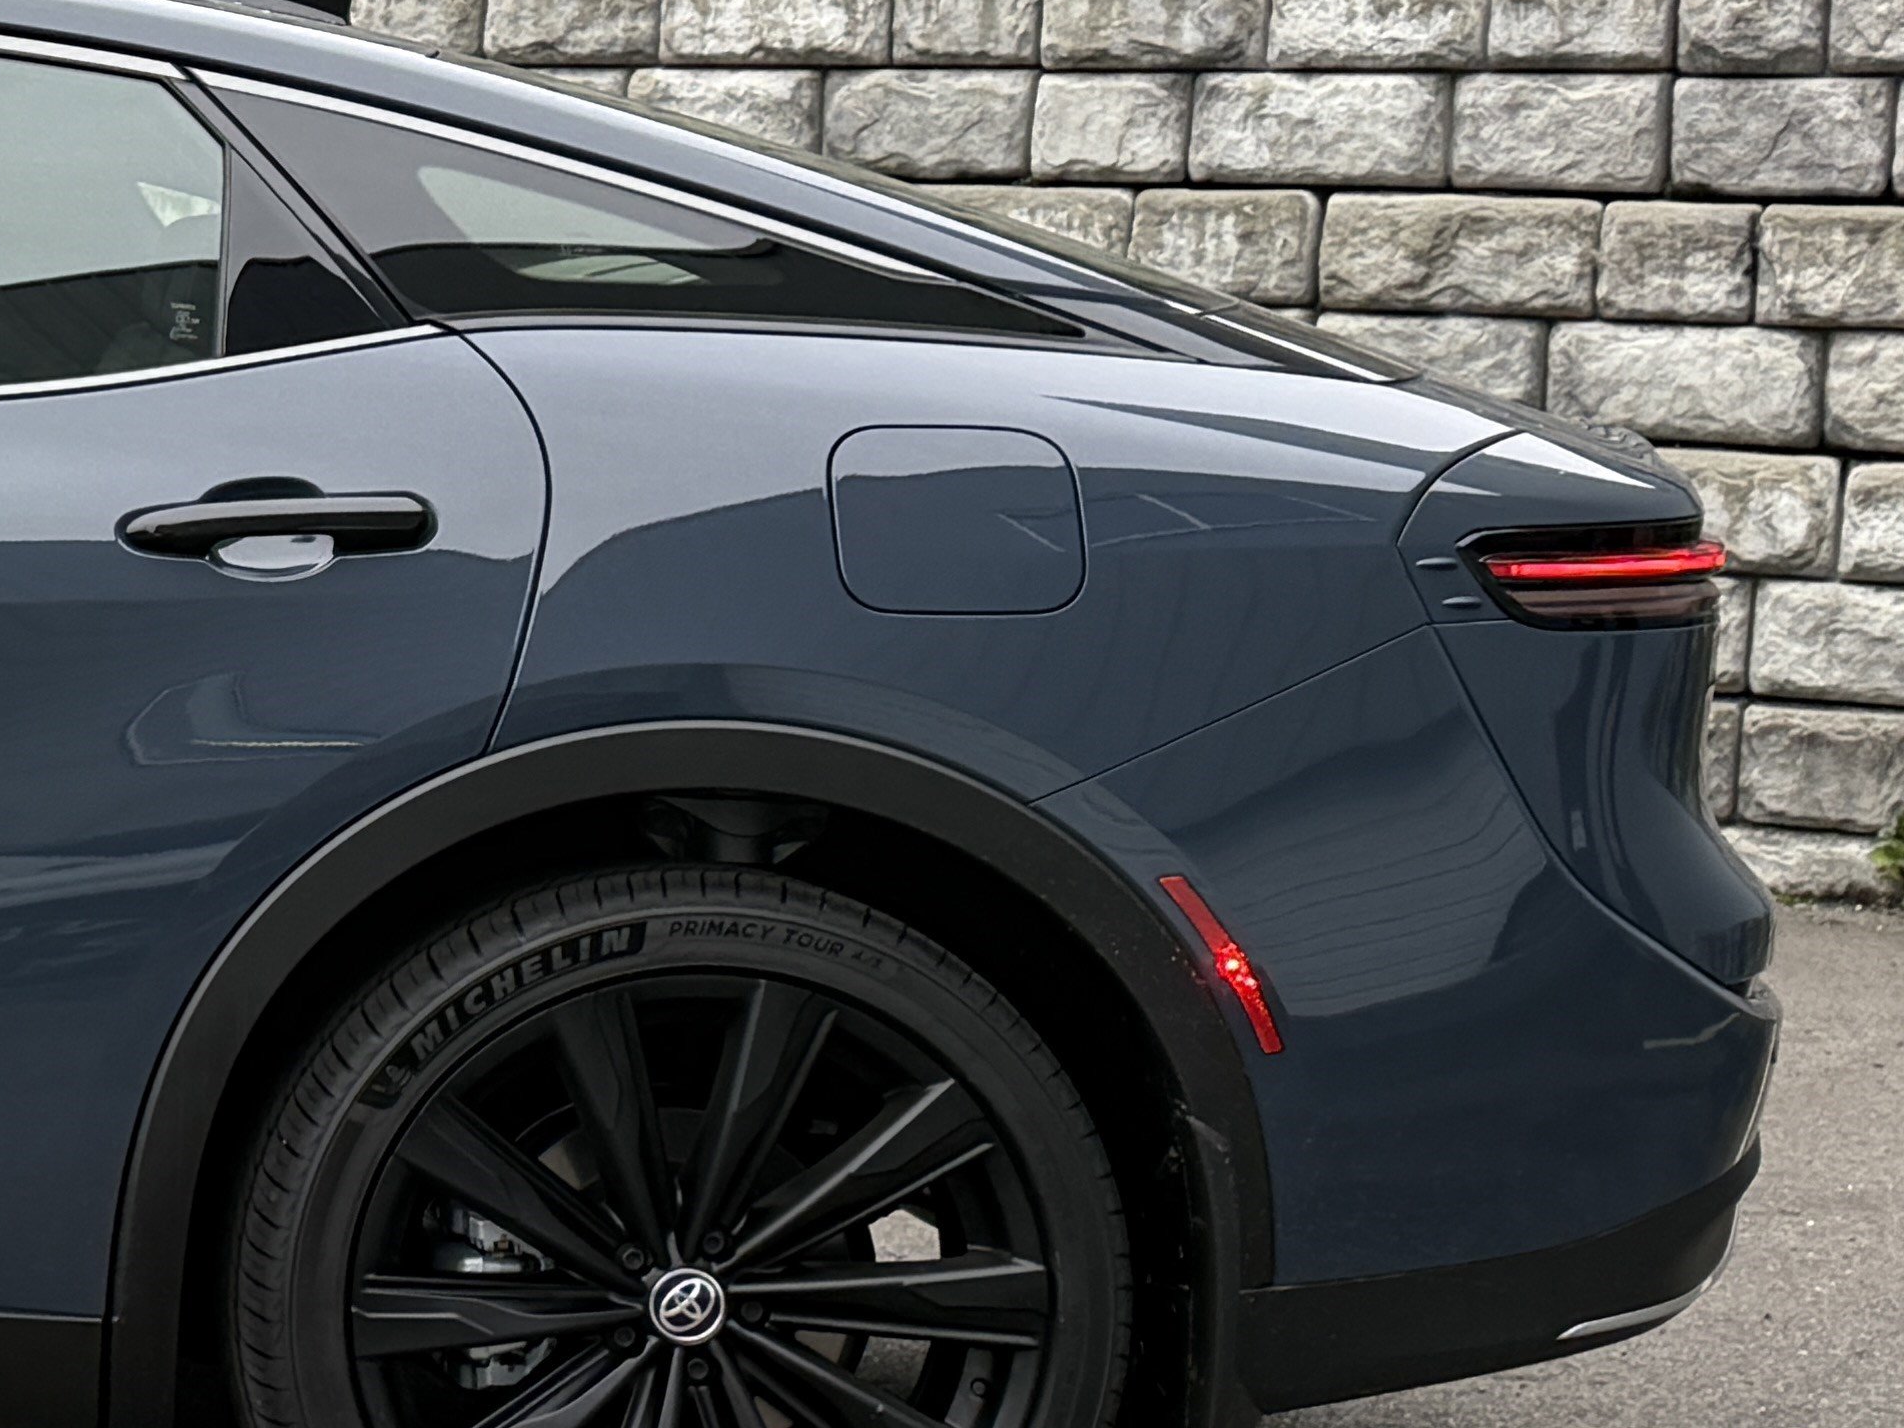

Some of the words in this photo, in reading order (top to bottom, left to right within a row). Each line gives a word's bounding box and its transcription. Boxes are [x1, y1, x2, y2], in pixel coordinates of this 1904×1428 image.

[668, 919, 774, 941] PRIMACY
[782, 928, 845, 957] TOUR
[410, 925, 632, 1063] MICHELIN
